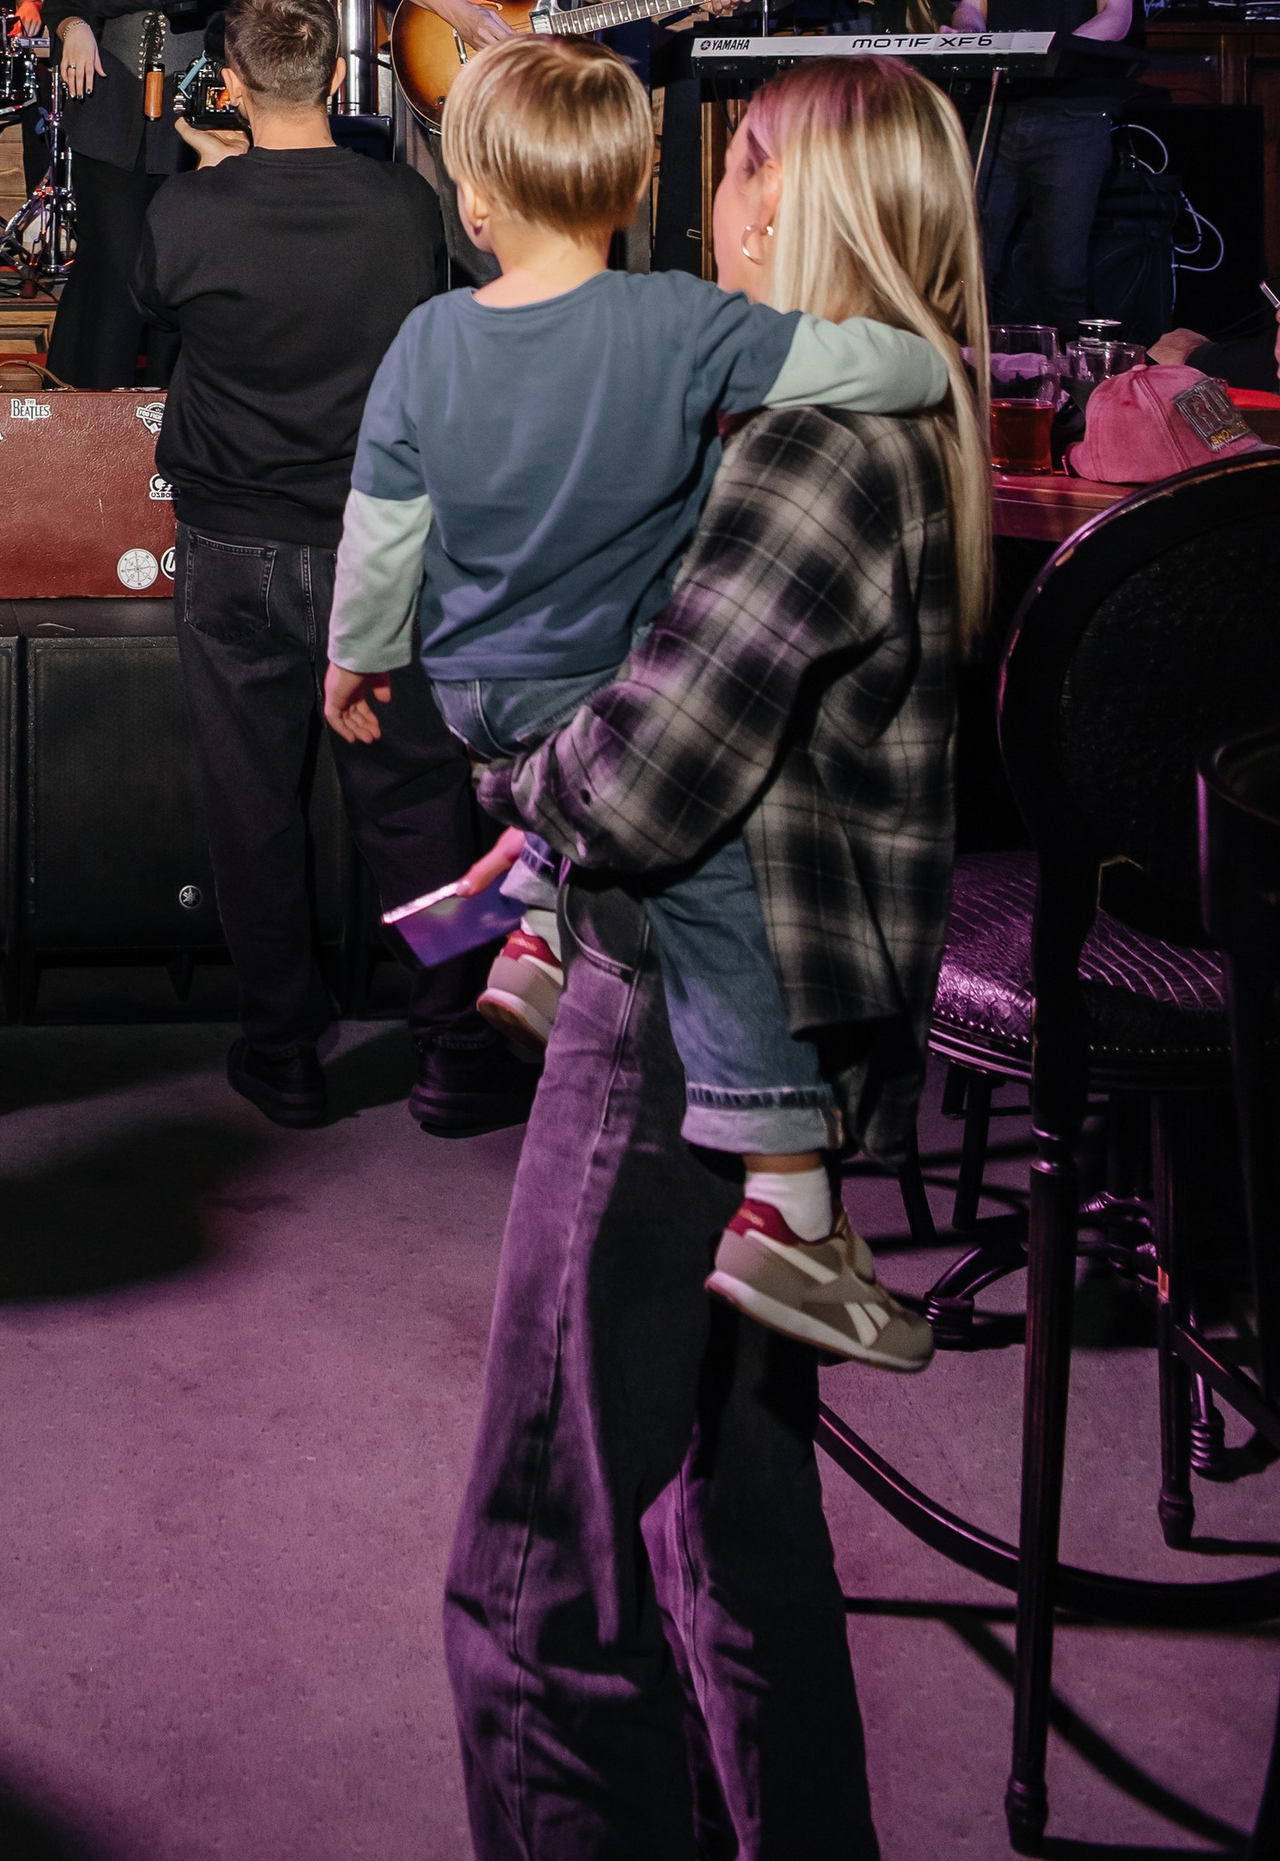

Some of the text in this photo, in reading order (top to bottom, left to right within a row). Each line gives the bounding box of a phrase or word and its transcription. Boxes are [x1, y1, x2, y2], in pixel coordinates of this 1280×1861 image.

[711, 39, 750, 51] YAMAHA
[852, 35, 993, 49] MOTIF XF6
